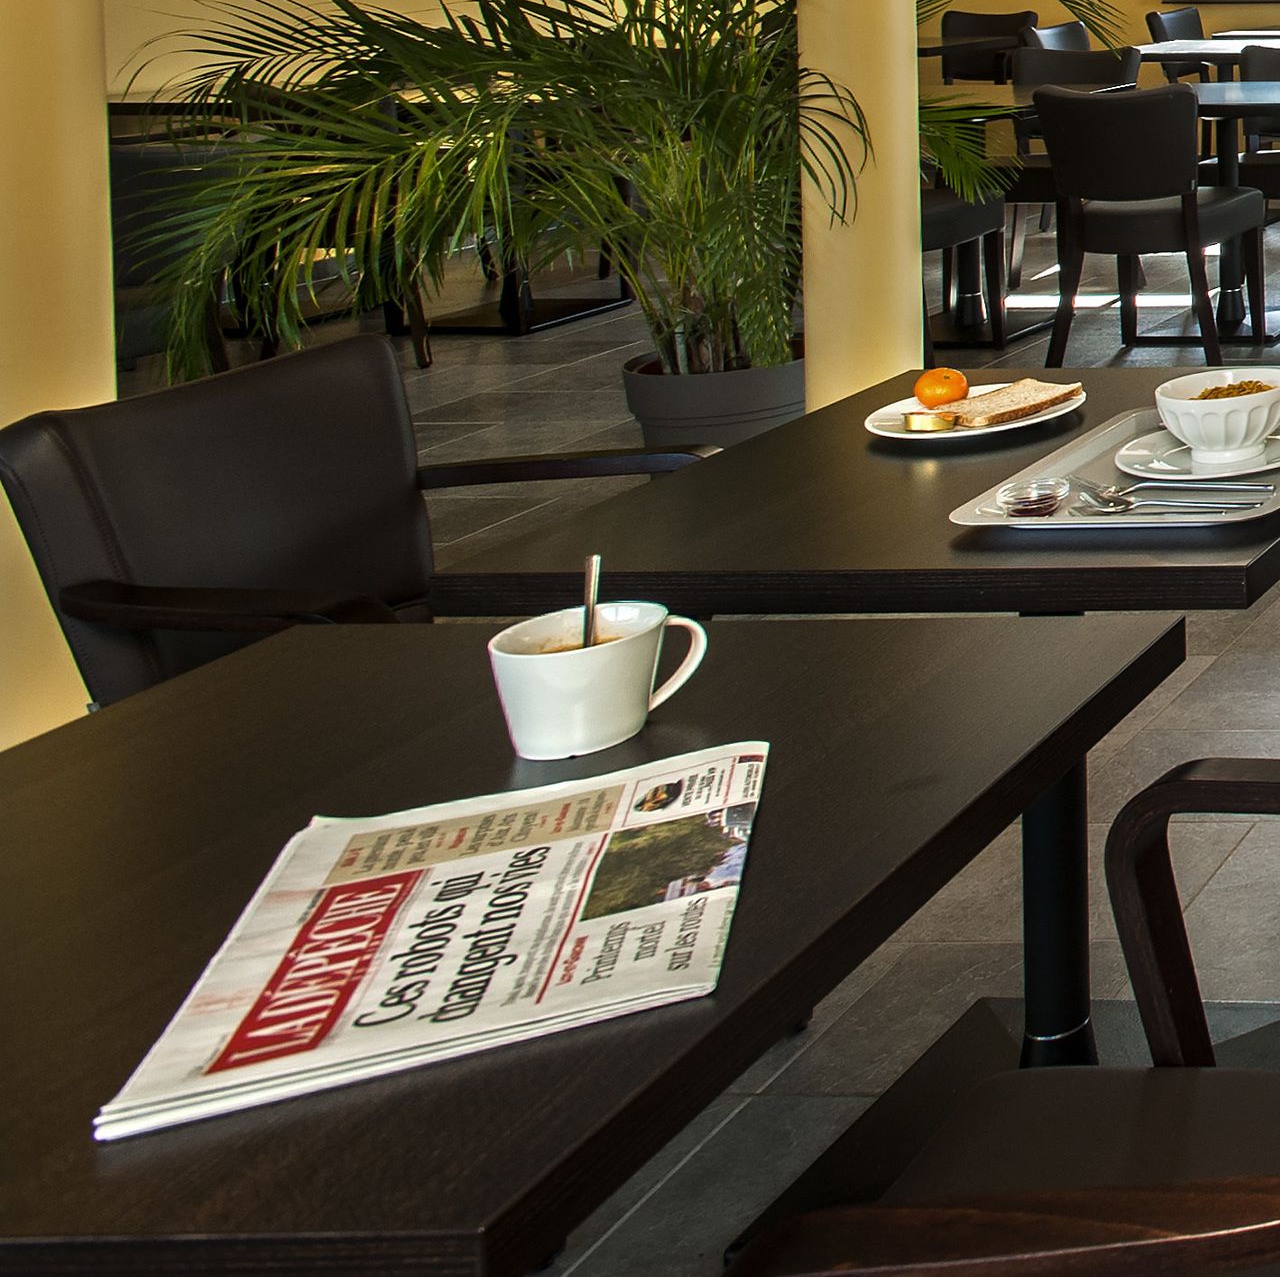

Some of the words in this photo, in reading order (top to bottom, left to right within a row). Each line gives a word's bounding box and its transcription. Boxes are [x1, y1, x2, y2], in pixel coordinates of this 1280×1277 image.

[431, 871, 492, 903] qui
[490, 846, 551, 884] vies
[480, 881, 533, 926] nos
[678, 897, 708, 933] routes
[259, 884, 402, 1019] DÉPÊCHE
[390, 903, 466, 981] robots
[579, 921, 637, 986] Printemps
[633, 920, 667, 962] mortel
[664, 931, 699, 953] les
[667, 950, 693, 972] sur
[417, 923, 518, 1023] changent
[352, 979, 429, 1028] Ces
[229, 1010, 329, 1061] LA
